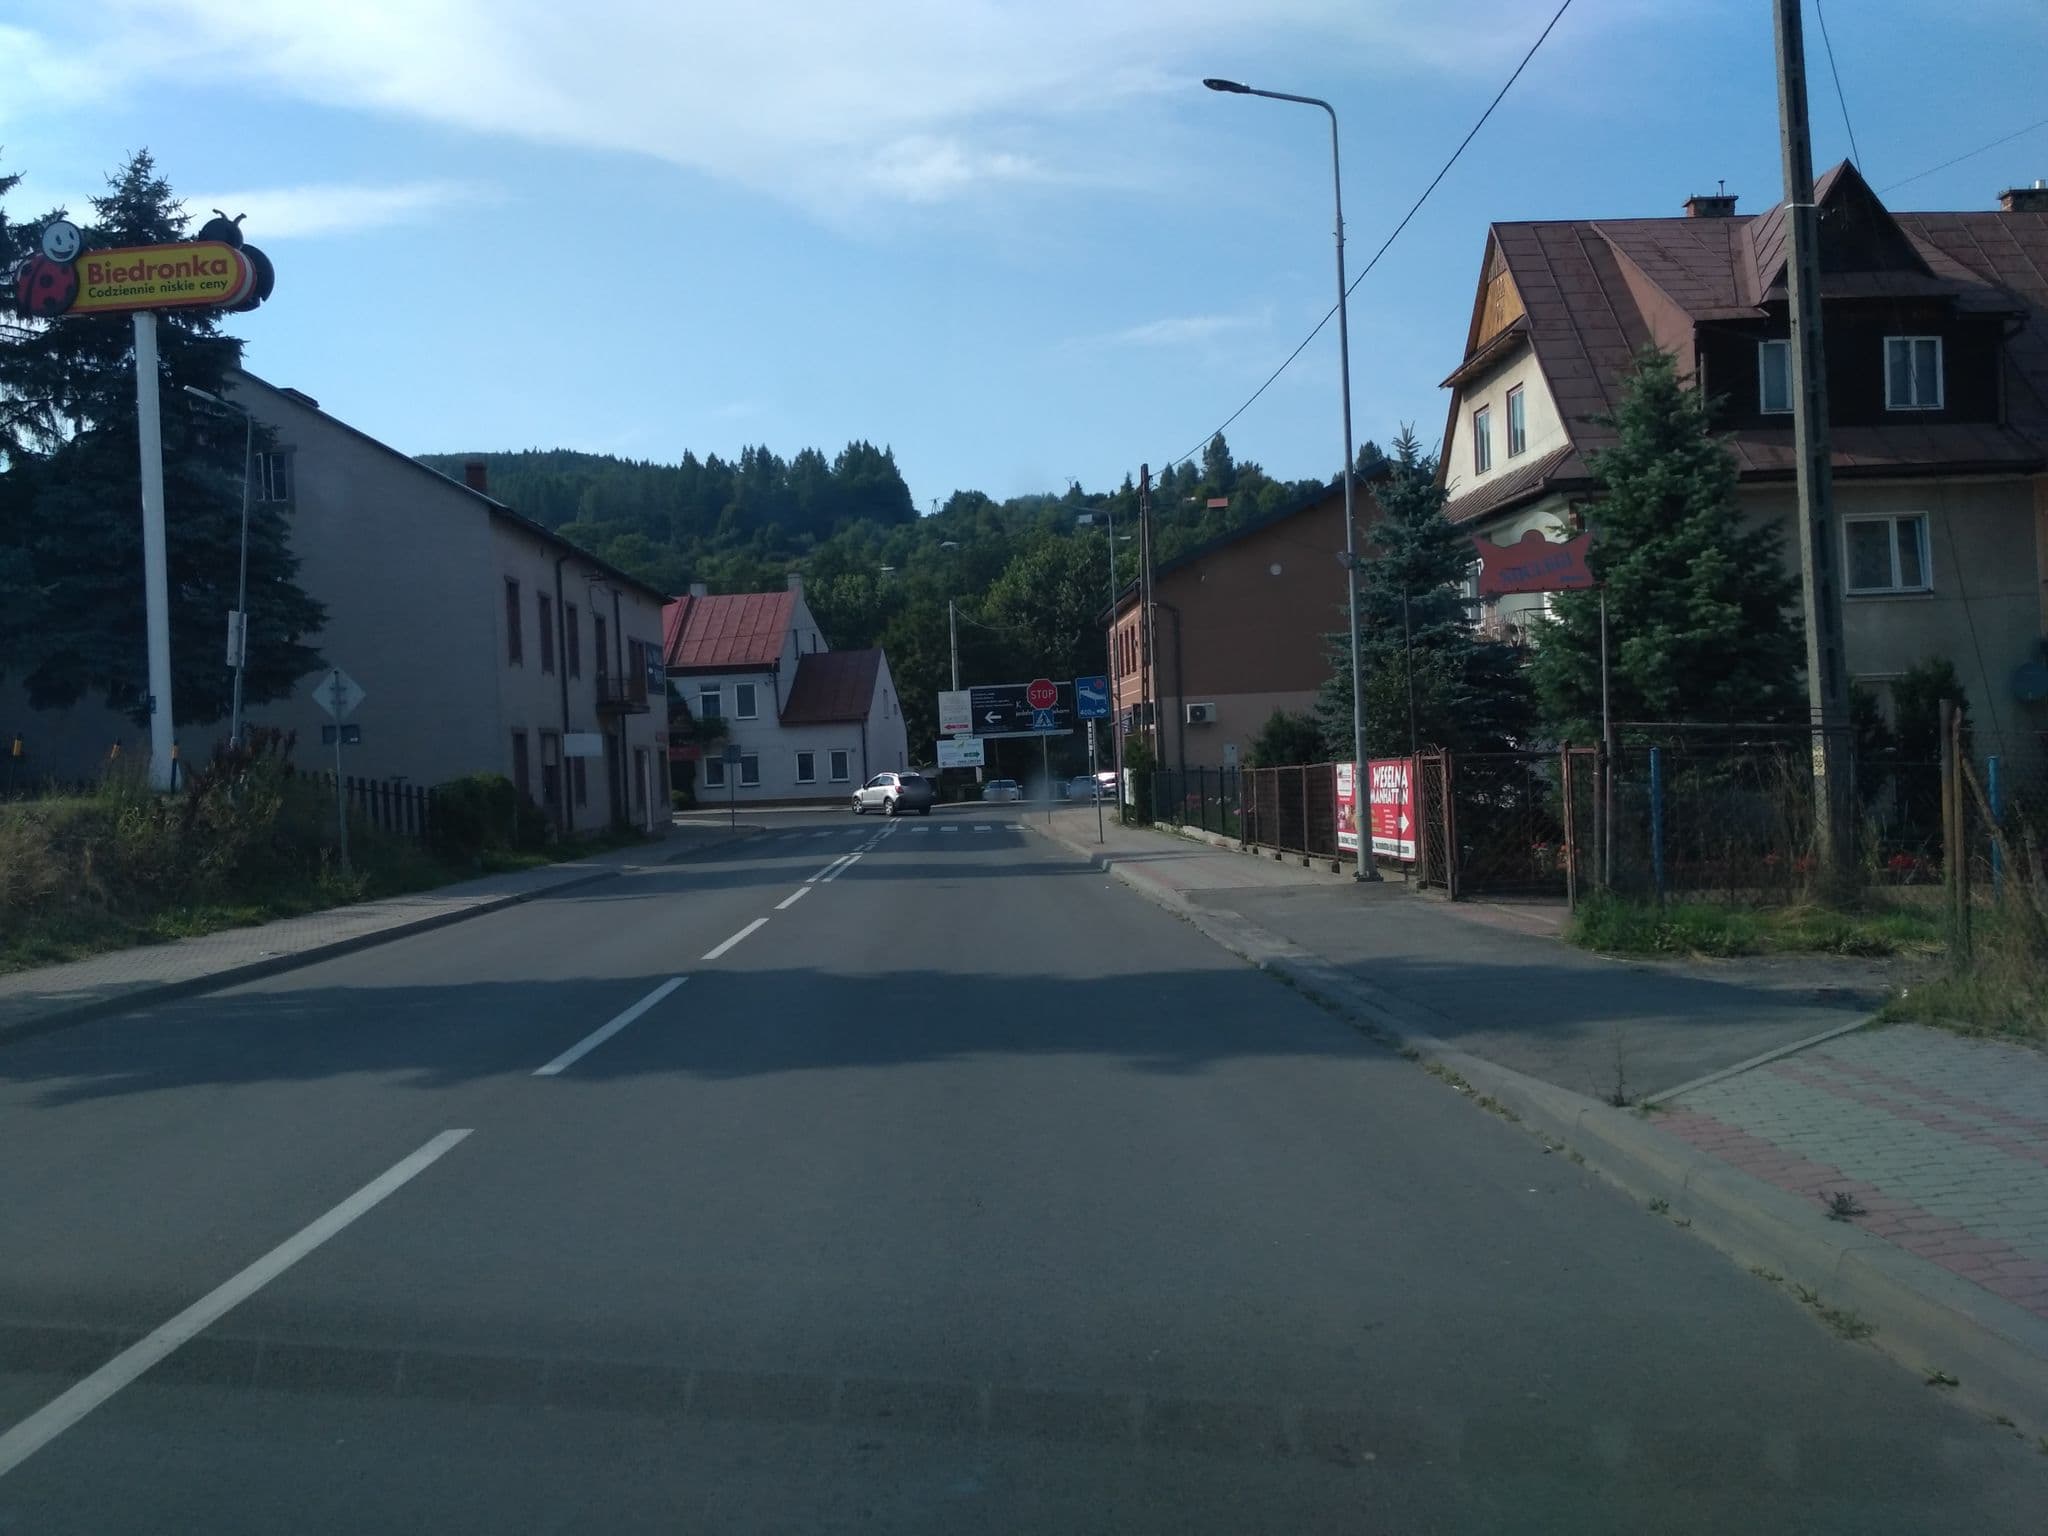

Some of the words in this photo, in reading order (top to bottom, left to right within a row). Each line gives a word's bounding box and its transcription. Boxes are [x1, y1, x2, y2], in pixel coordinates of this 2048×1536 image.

[87, 255, 228, 285] Biedronka
[88, 281, 155, 298] Codziennie
[160, 280, 195, 293] niskie
[200, 279, 228, 293] ceny
[1031, 689, 1055, 700] STOP
[1373, 766, 1408, 789] WESELNA
